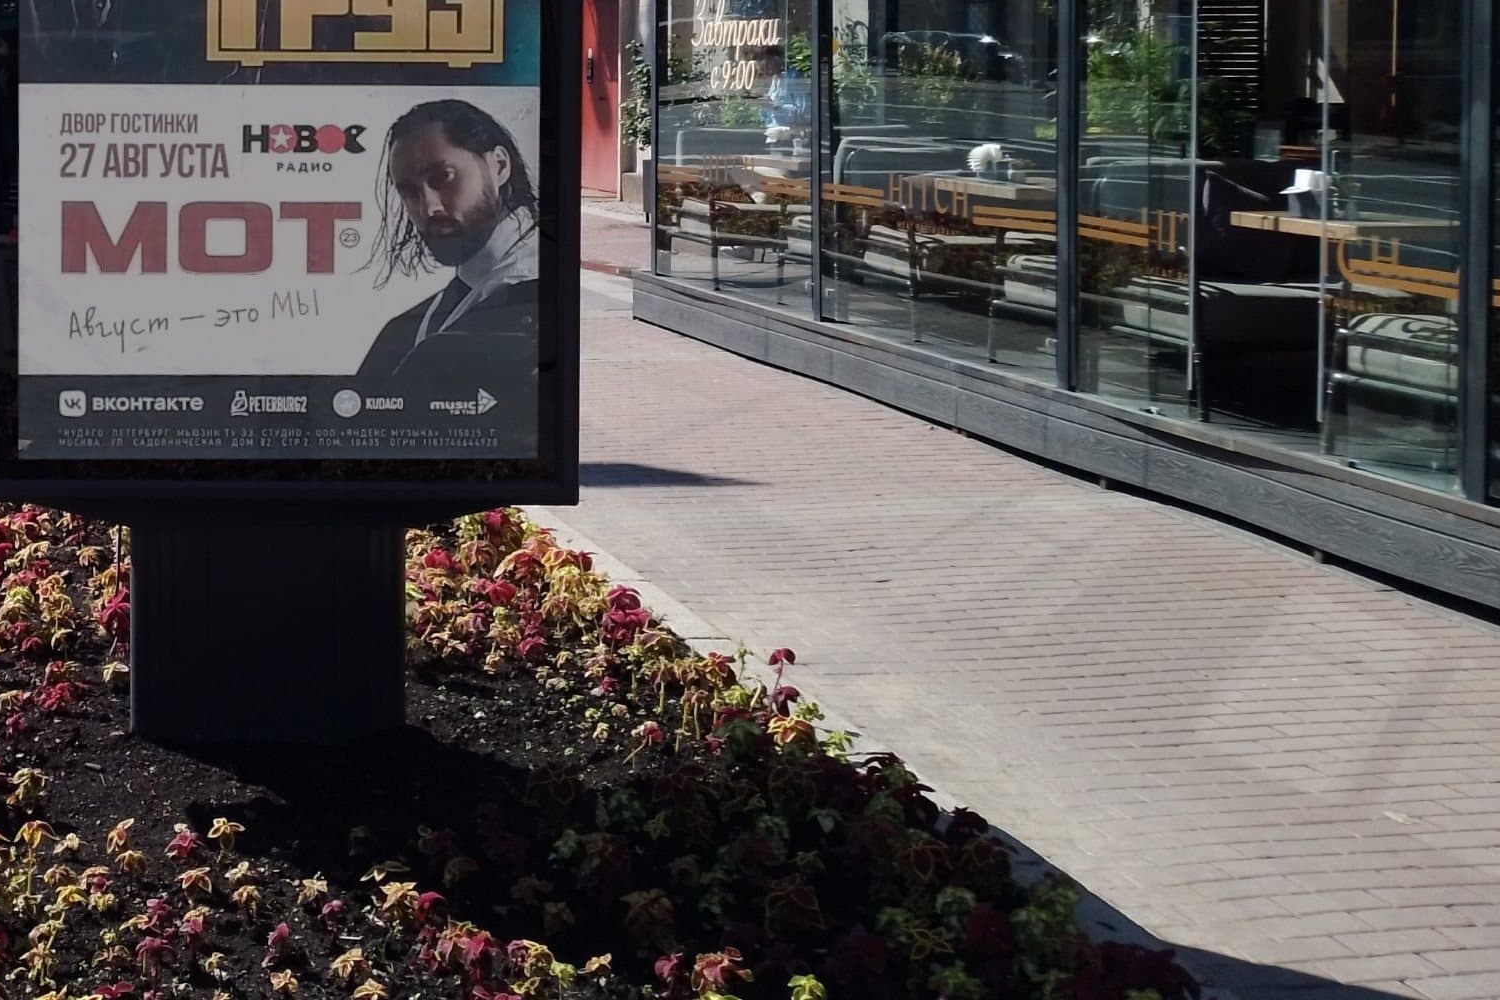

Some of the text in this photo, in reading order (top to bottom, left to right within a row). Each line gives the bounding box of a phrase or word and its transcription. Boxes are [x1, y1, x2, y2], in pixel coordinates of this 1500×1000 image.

[721, 60, 756, 90] 9:00
[60, 113, 198, 135] ДВОР ГОСТИНКИ
[60, 143, 229, 178] 27 АВГУСТА
[276, 162, 332, 173] РАДИО
[890, 173, 968, 217] HITCH
[61, 201, 362, 275] МОТ
[69, 306, 169, 353] Август
[214, 307, 259, 327] это
[271, 288, 320, 319] МЫ
